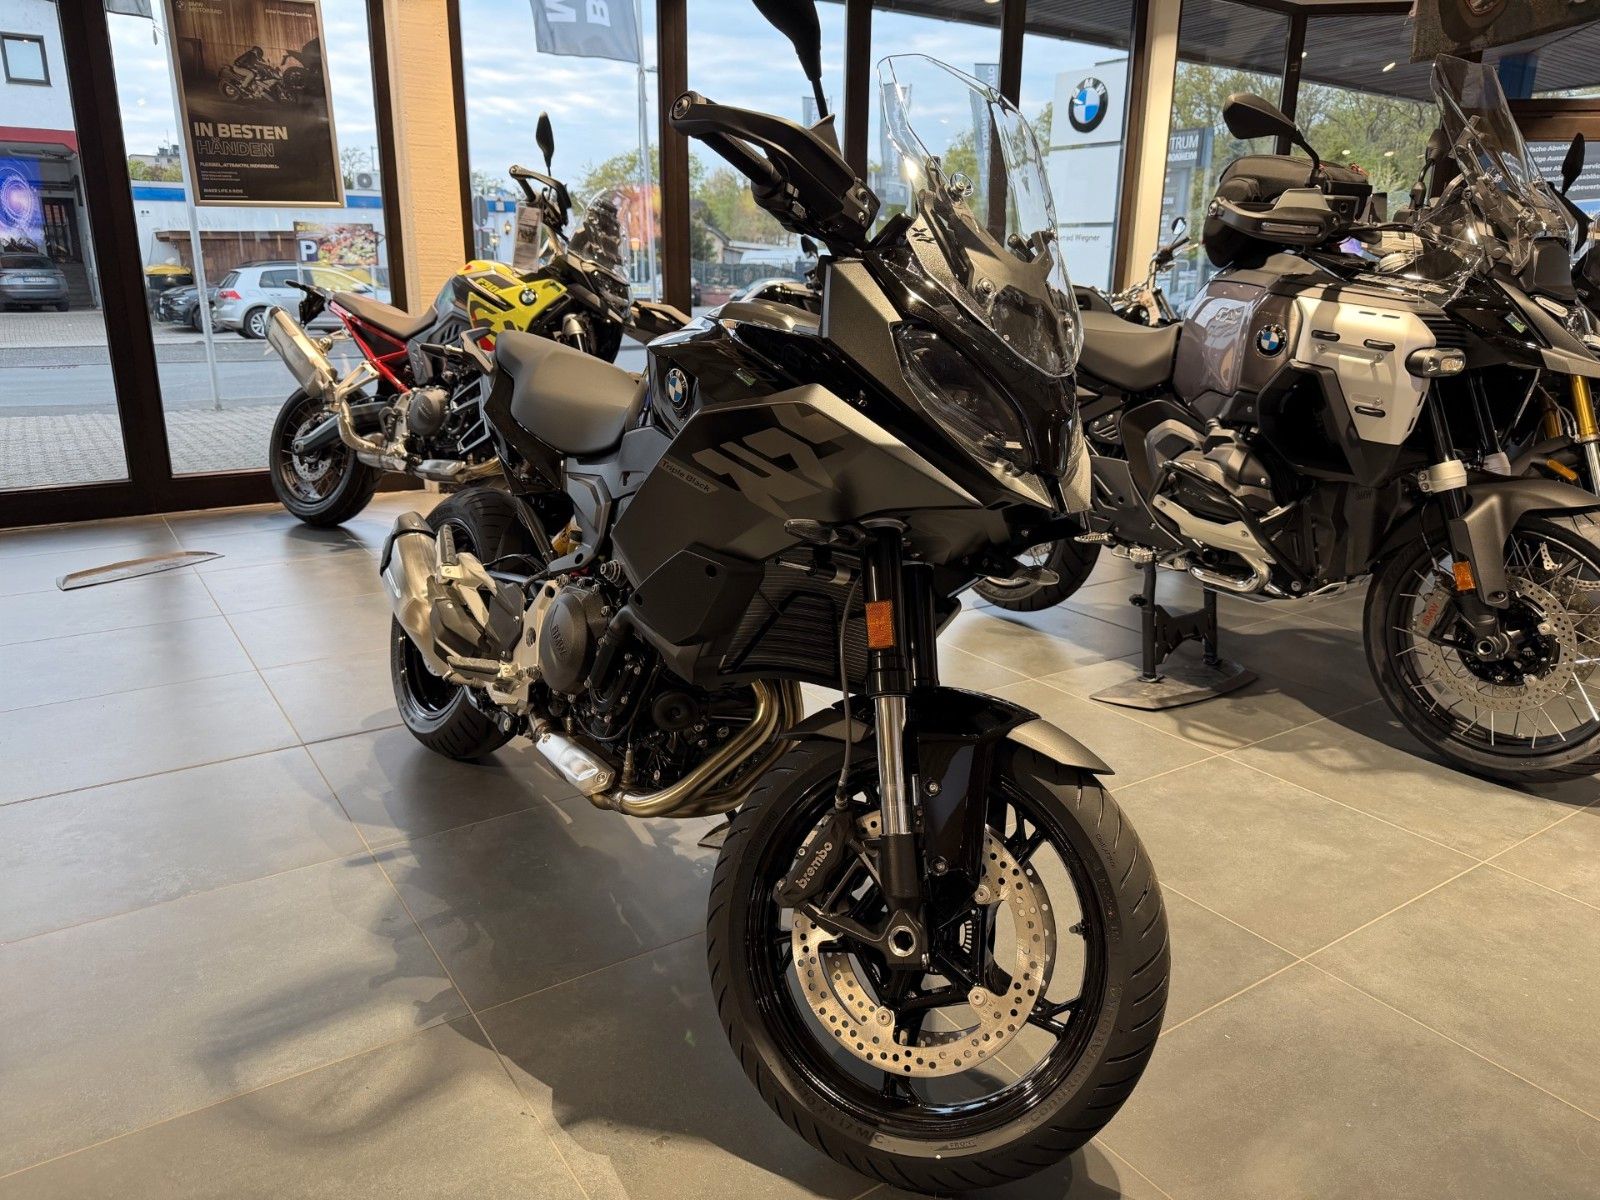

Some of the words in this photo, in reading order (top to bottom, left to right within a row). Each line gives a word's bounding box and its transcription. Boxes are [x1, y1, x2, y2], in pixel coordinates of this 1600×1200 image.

[194, 122, 214, 137] IN
[217, 123, 289, 140] BESTEN
[197, 137, 275, 158] HÄNDEN
[300, 240, 318, 262] P
[661, 460, 685, 478] Triple
[685, 474, 711, 493] Black
[1423, 602, 1440, 625] BMW
[551, 624, 569, 657] BMW
[795, 841, 833, 889] brembo
